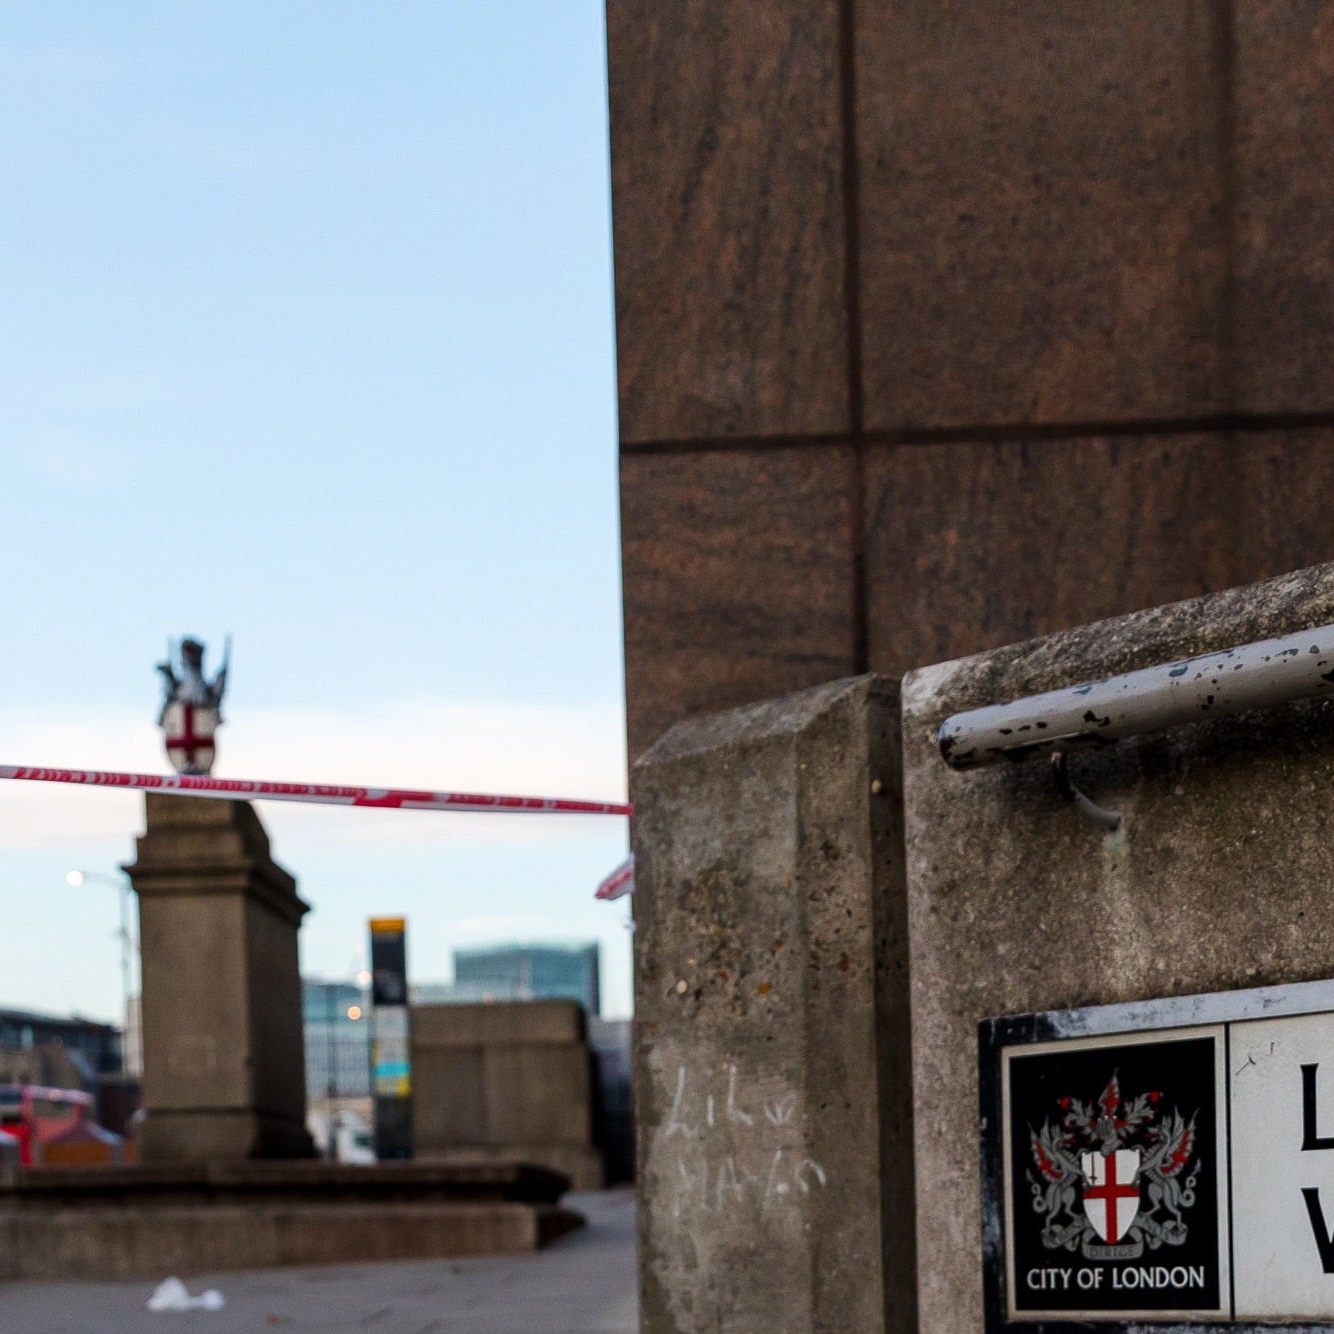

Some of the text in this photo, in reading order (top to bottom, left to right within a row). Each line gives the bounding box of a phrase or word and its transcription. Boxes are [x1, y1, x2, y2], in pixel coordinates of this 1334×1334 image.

[1027, 1265, 1205, 1290] CITY OF LONDON
